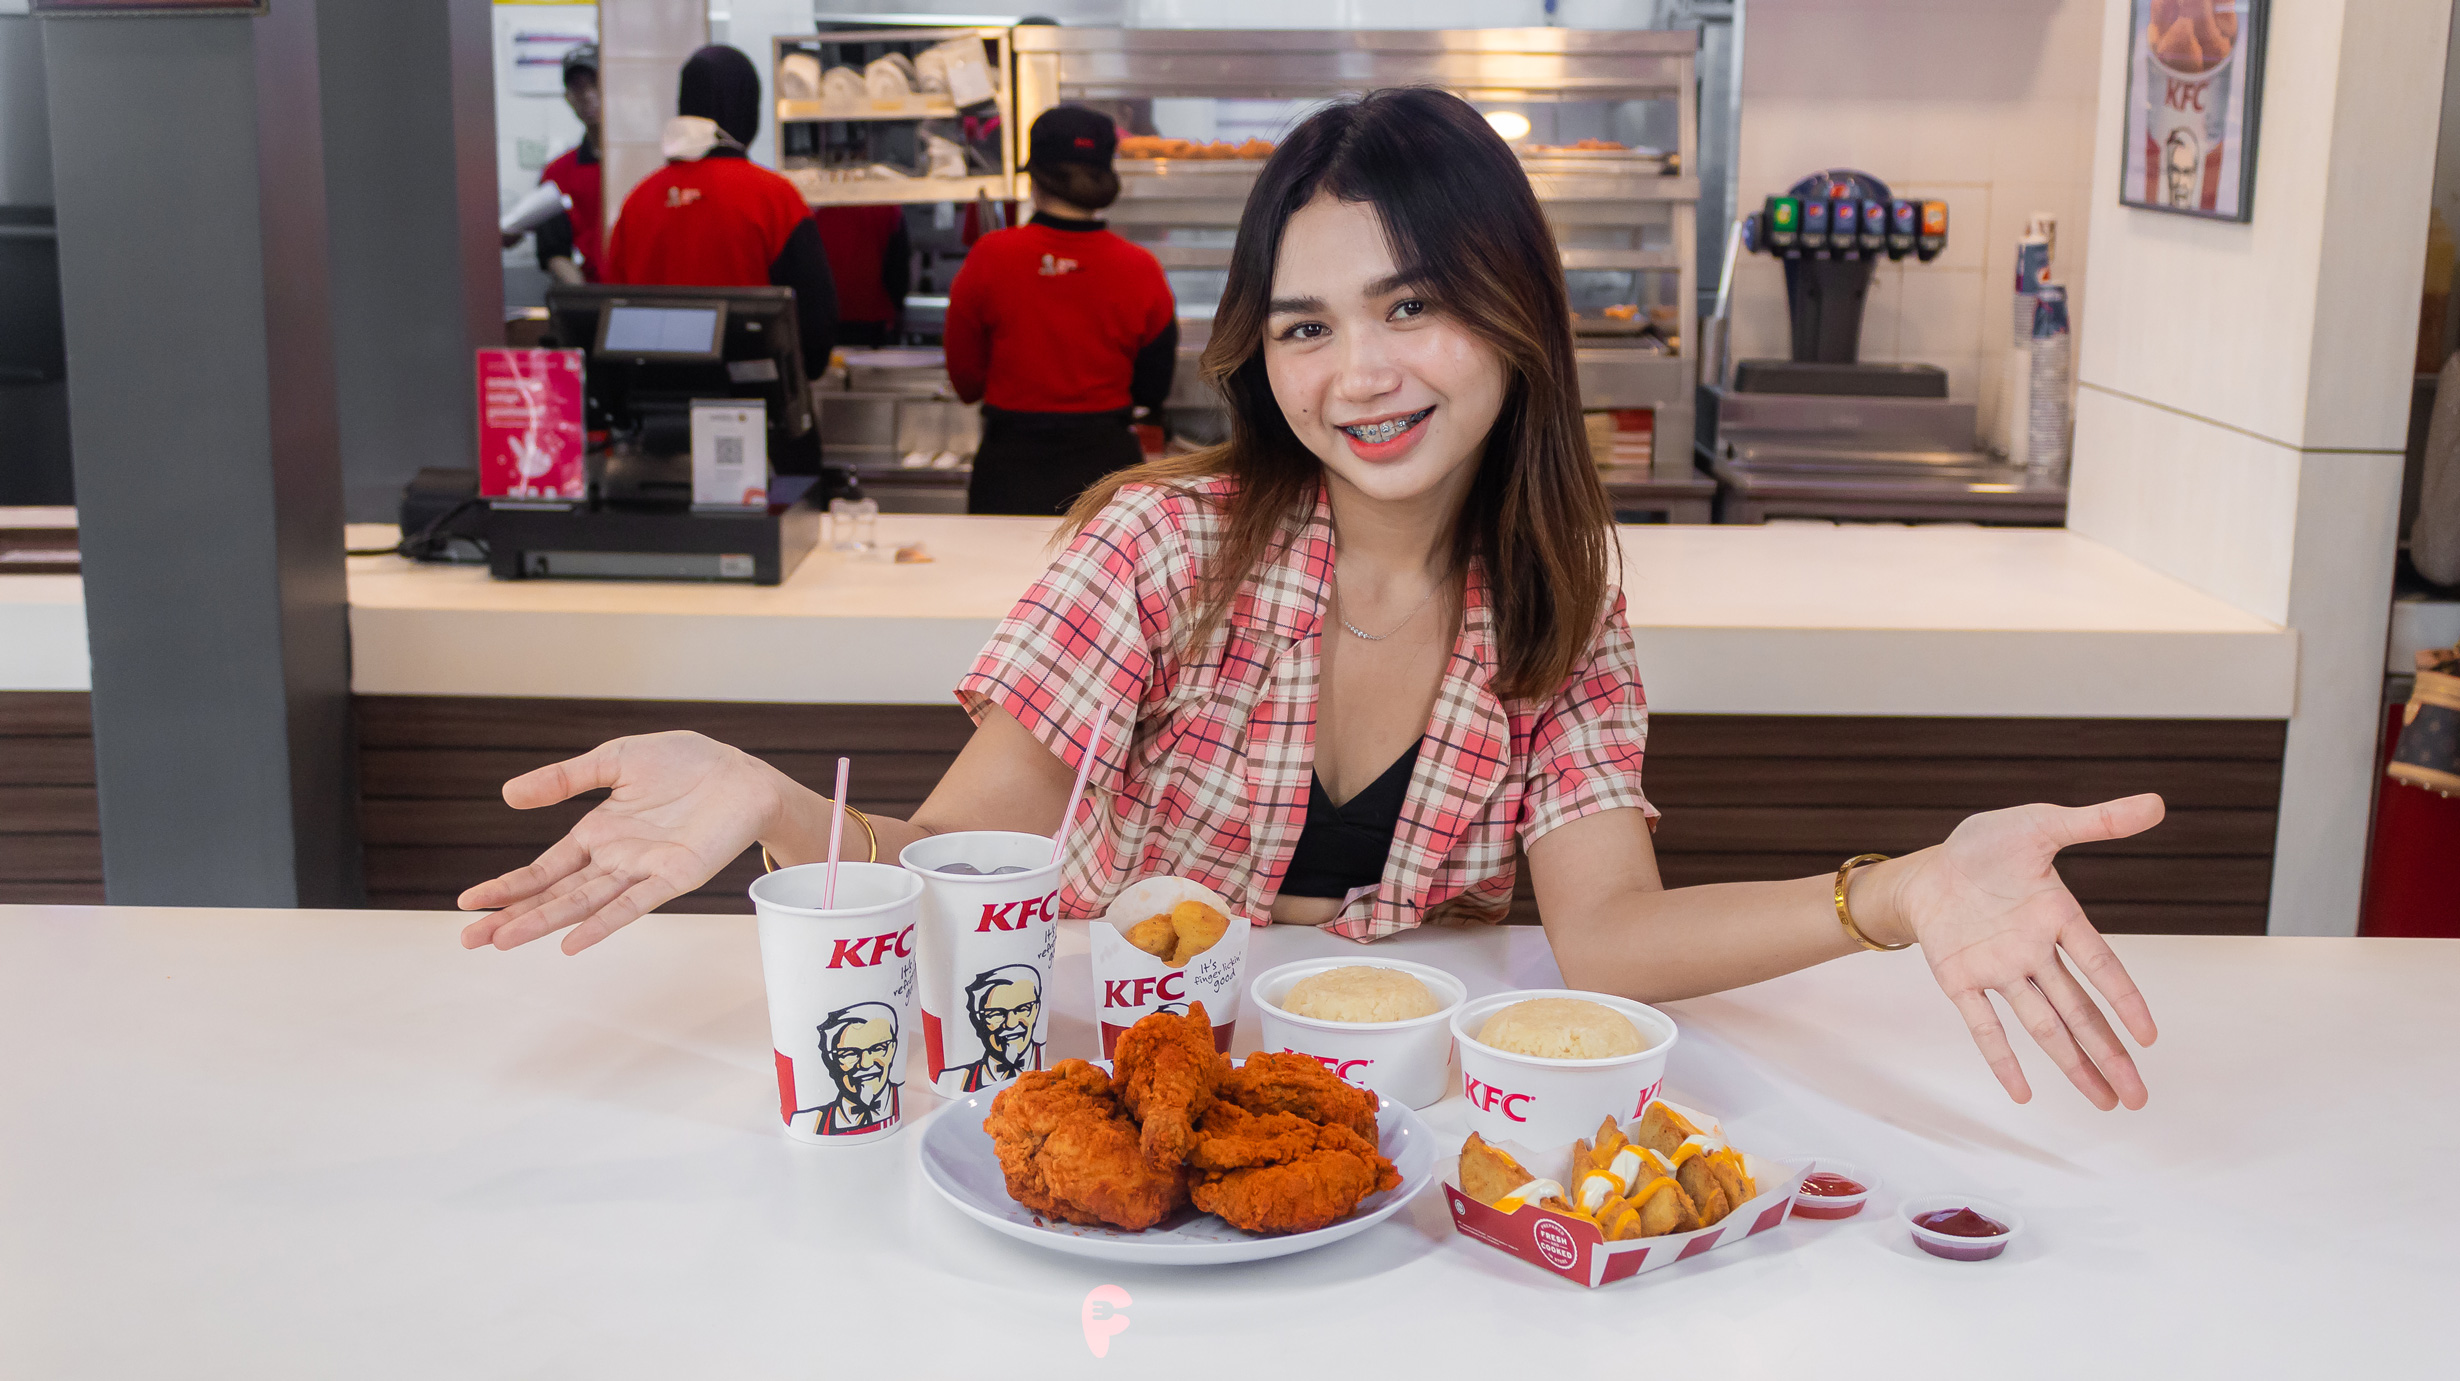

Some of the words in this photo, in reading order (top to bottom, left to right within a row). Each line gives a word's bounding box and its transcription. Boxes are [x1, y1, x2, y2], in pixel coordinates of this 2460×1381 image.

[2164, 78, 2210, 112] KFC
[974, 888, 1058, 932] KFC
[825, 922, 915, 968] KFC
[1194, 969, 1221, 985] finger
[1200, 958, 1217, 974] It's
[1213, 967, 1236, 993] good
[1103, 971, 1185, 1008] KFC
[1464, 1070, 1531, 1123] KFC
[1540, 1230, 1568, 1245] FRESH
[1540, 1242, 1573, 1259] COOKED
